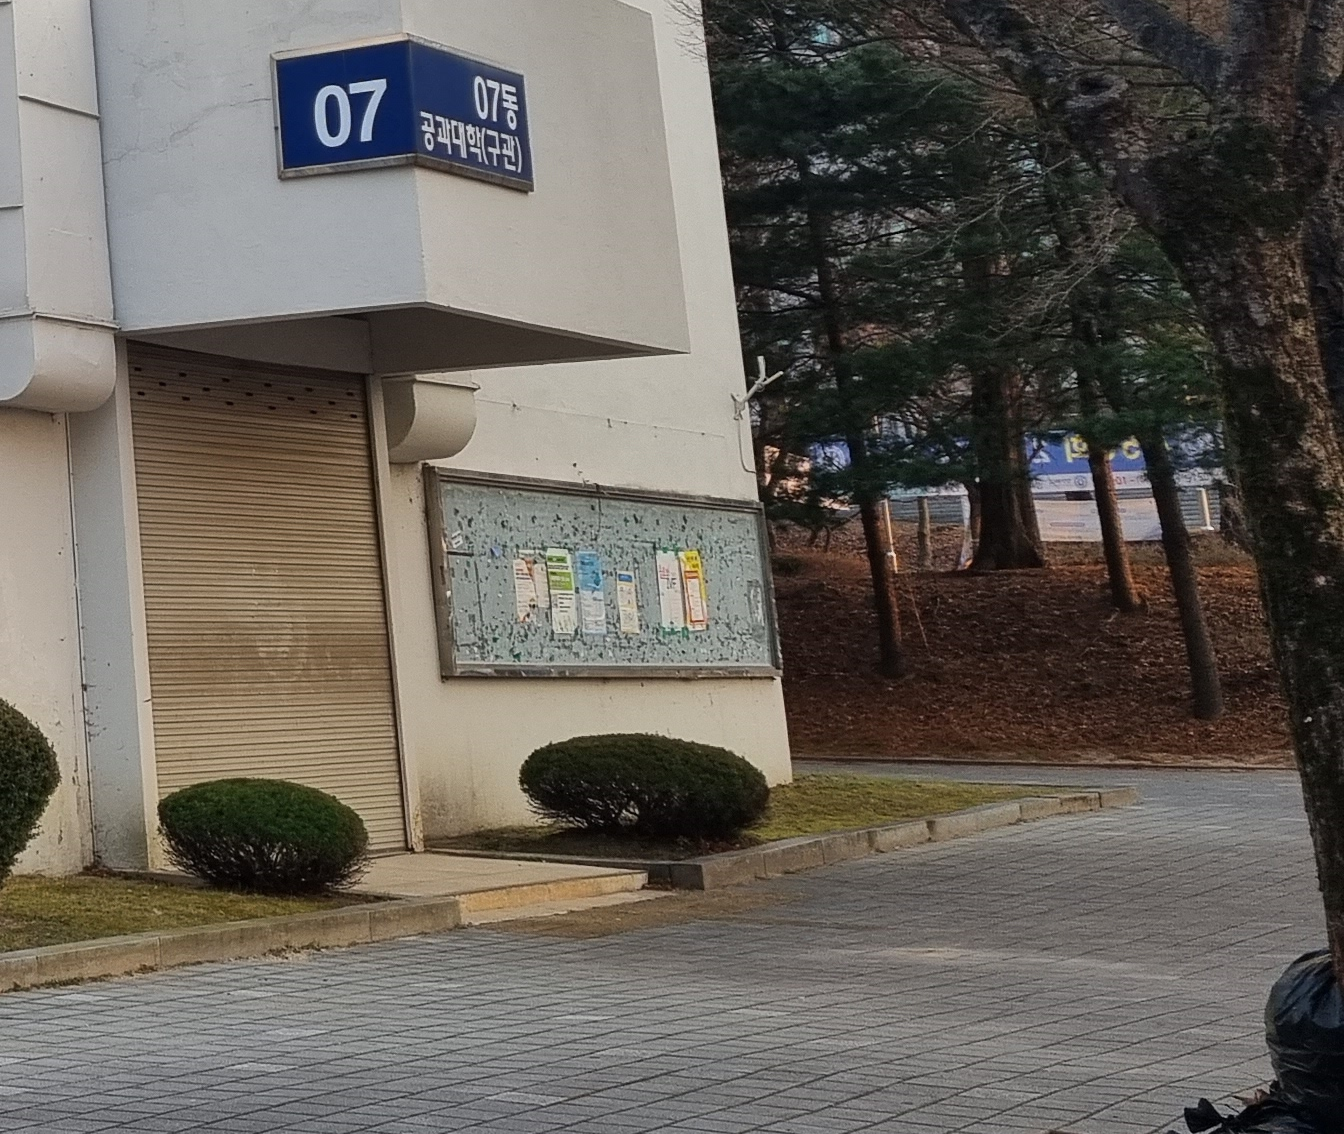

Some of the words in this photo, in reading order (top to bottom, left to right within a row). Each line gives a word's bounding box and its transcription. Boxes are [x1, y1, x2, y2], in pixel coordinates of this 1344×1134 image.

[313, 77, 387, 148] 07
[473, 75, 519, 131] 07동
[419, 111, 523, 173] 공과대학(구관)
